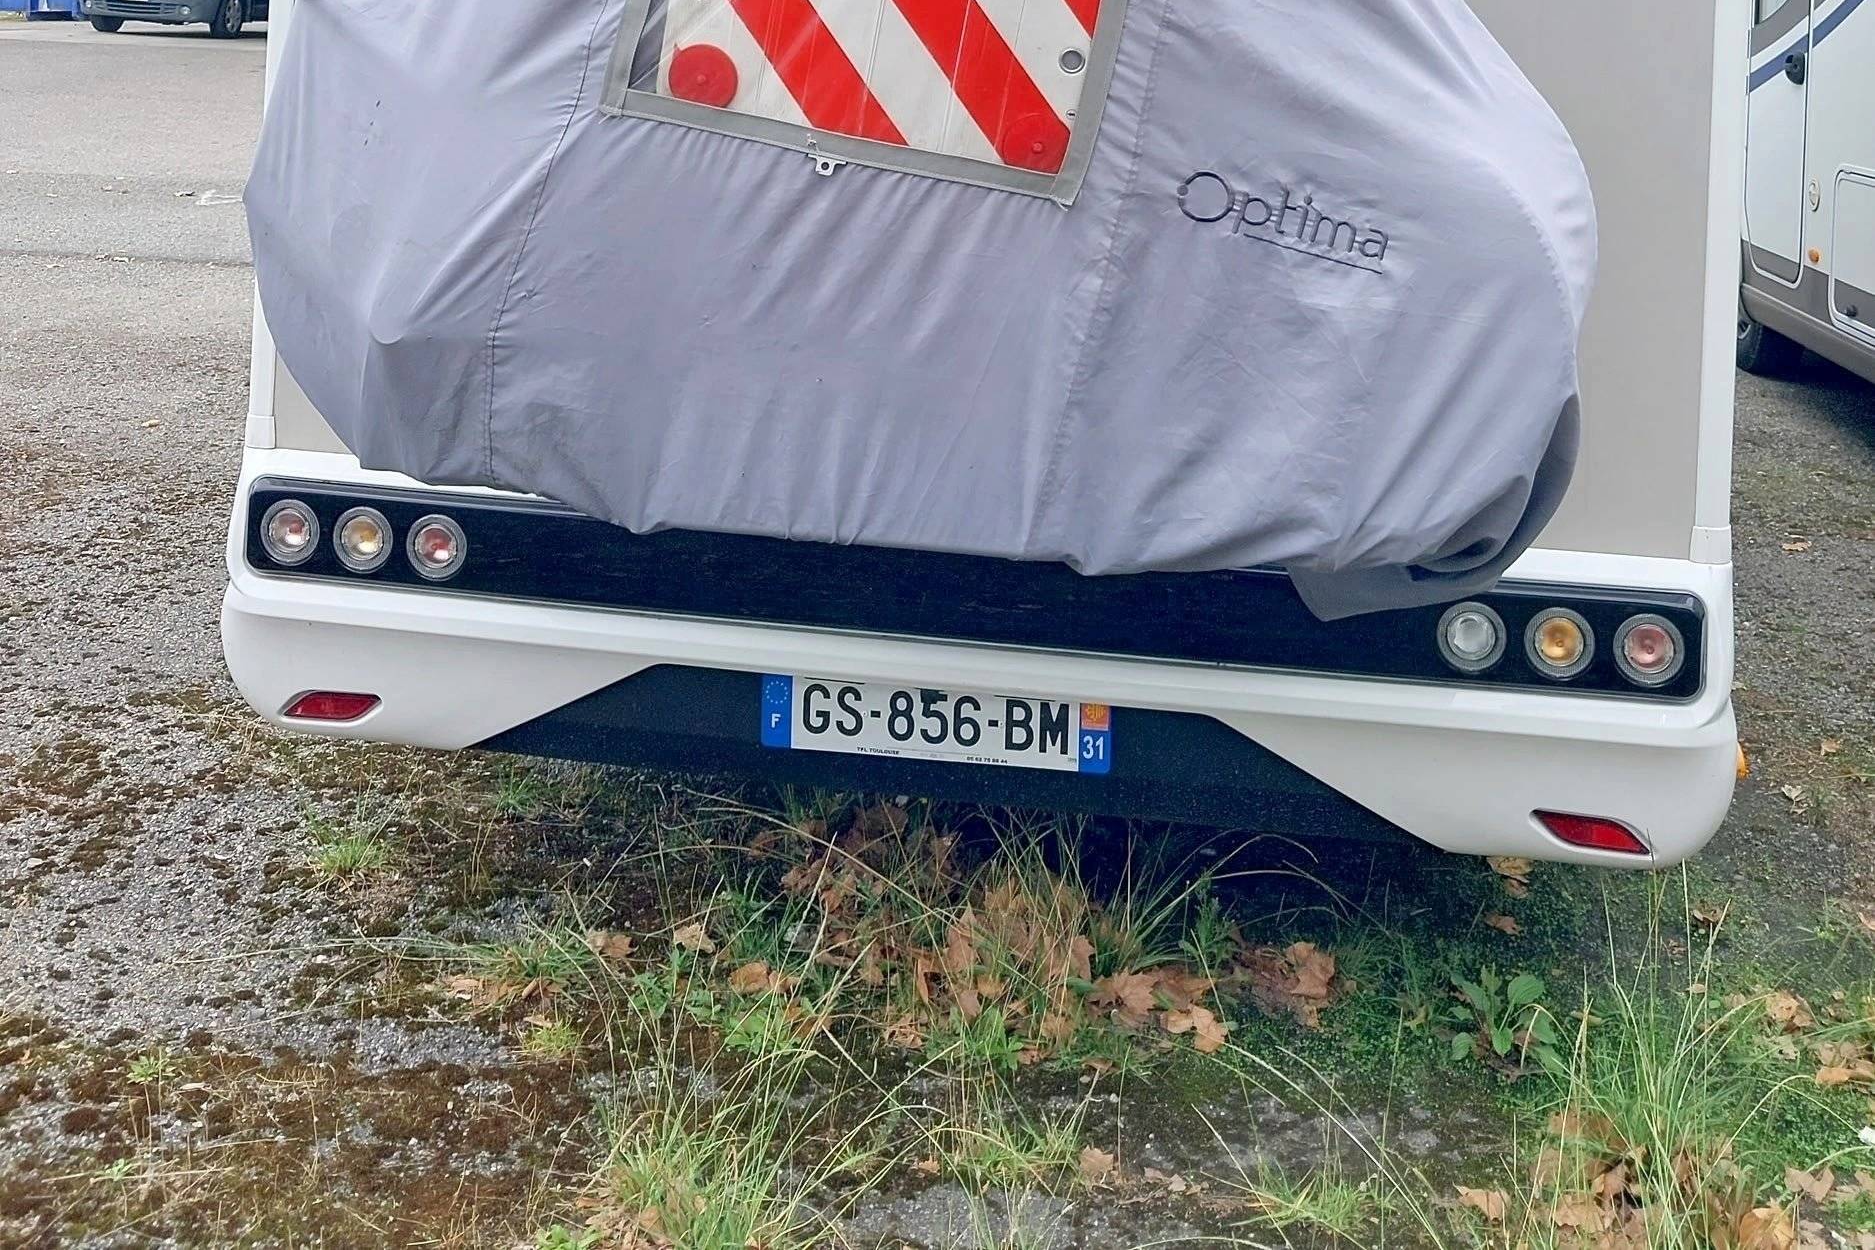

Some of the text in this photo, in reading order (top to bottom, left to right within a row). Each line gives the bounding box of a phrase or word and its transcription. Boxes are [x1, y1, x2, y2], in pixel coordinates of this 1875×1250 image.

[1177, 171, 1389, 261] Optima
[770, 713, 782, 729] F
[802, 683, 1070, 756] GS-856-BM
[1082, 735, 1104, 760] 31
